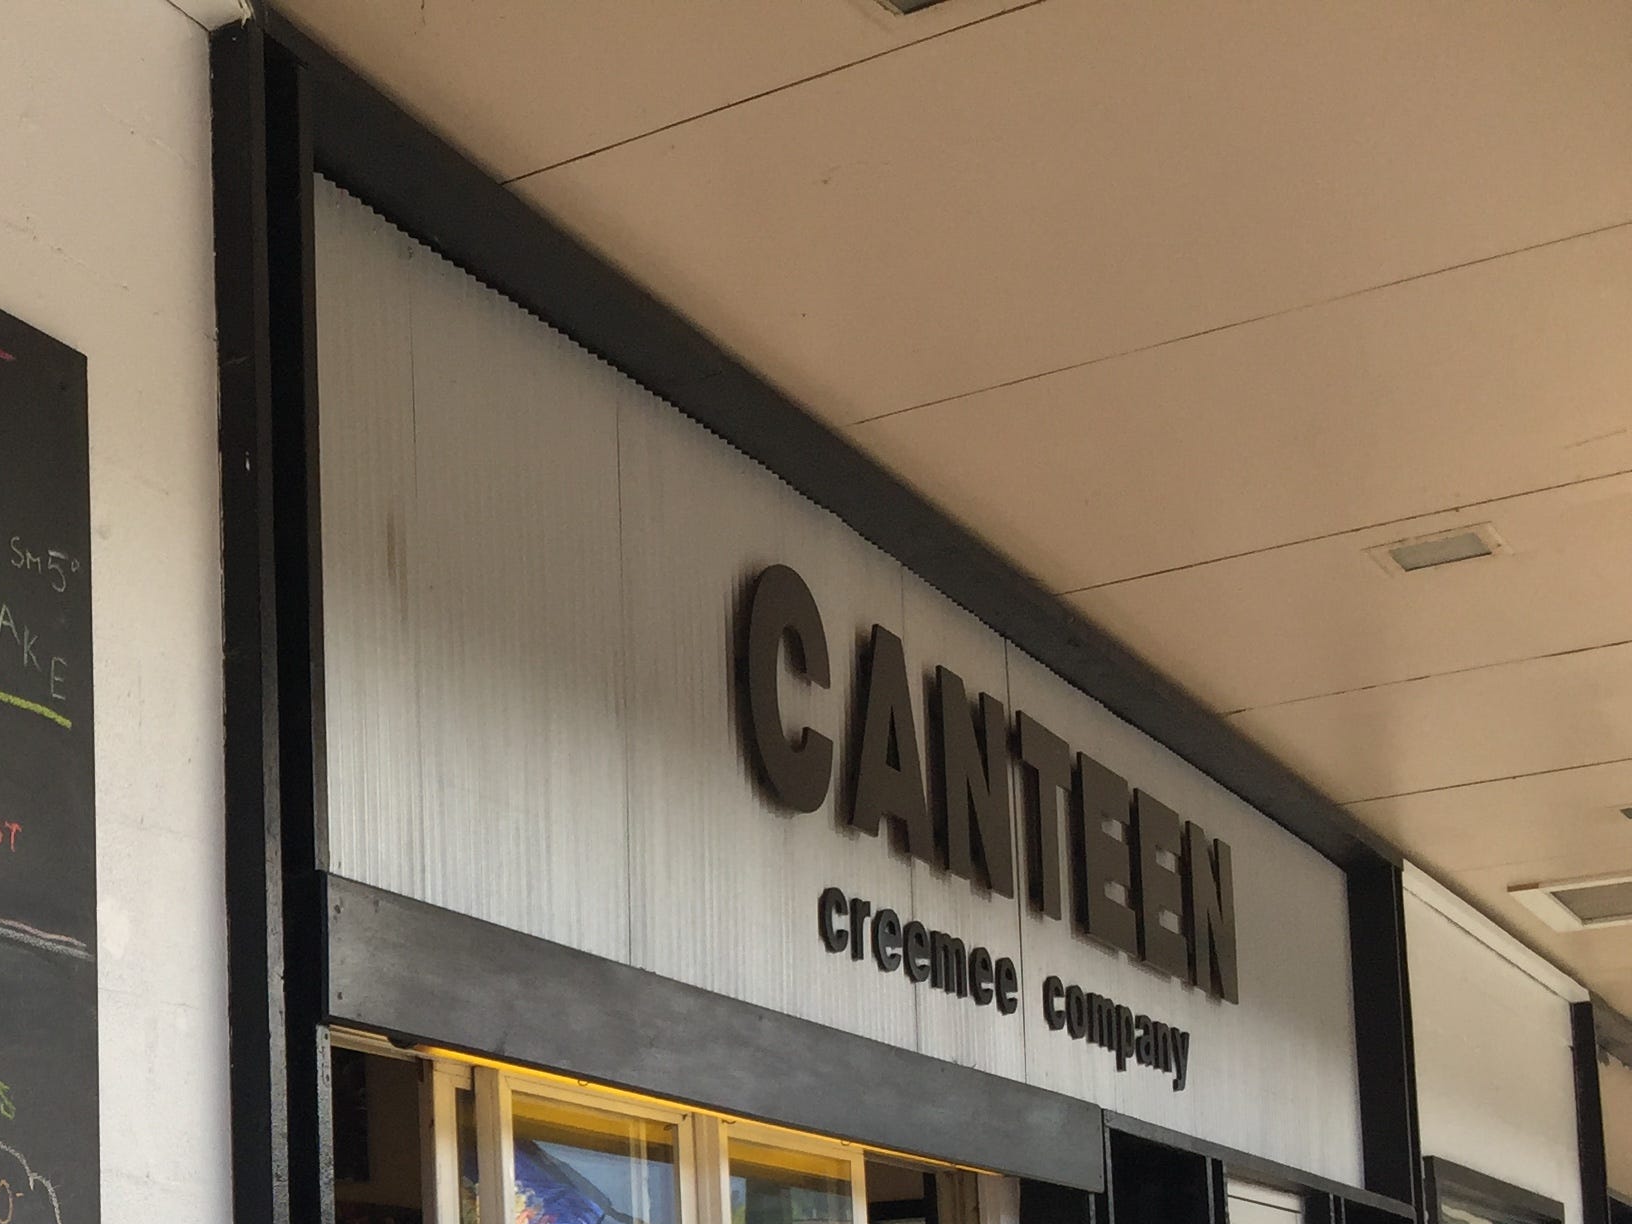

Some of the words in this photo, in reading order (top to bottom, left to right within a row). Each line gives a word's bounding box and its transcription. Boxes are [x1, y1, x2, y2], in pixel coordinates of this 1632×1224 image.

[738, 563, 1238, 1005] CANTEEN
[818, 887, 1018, 1014] creemee
[1043, 975, 1190, 1091] company
